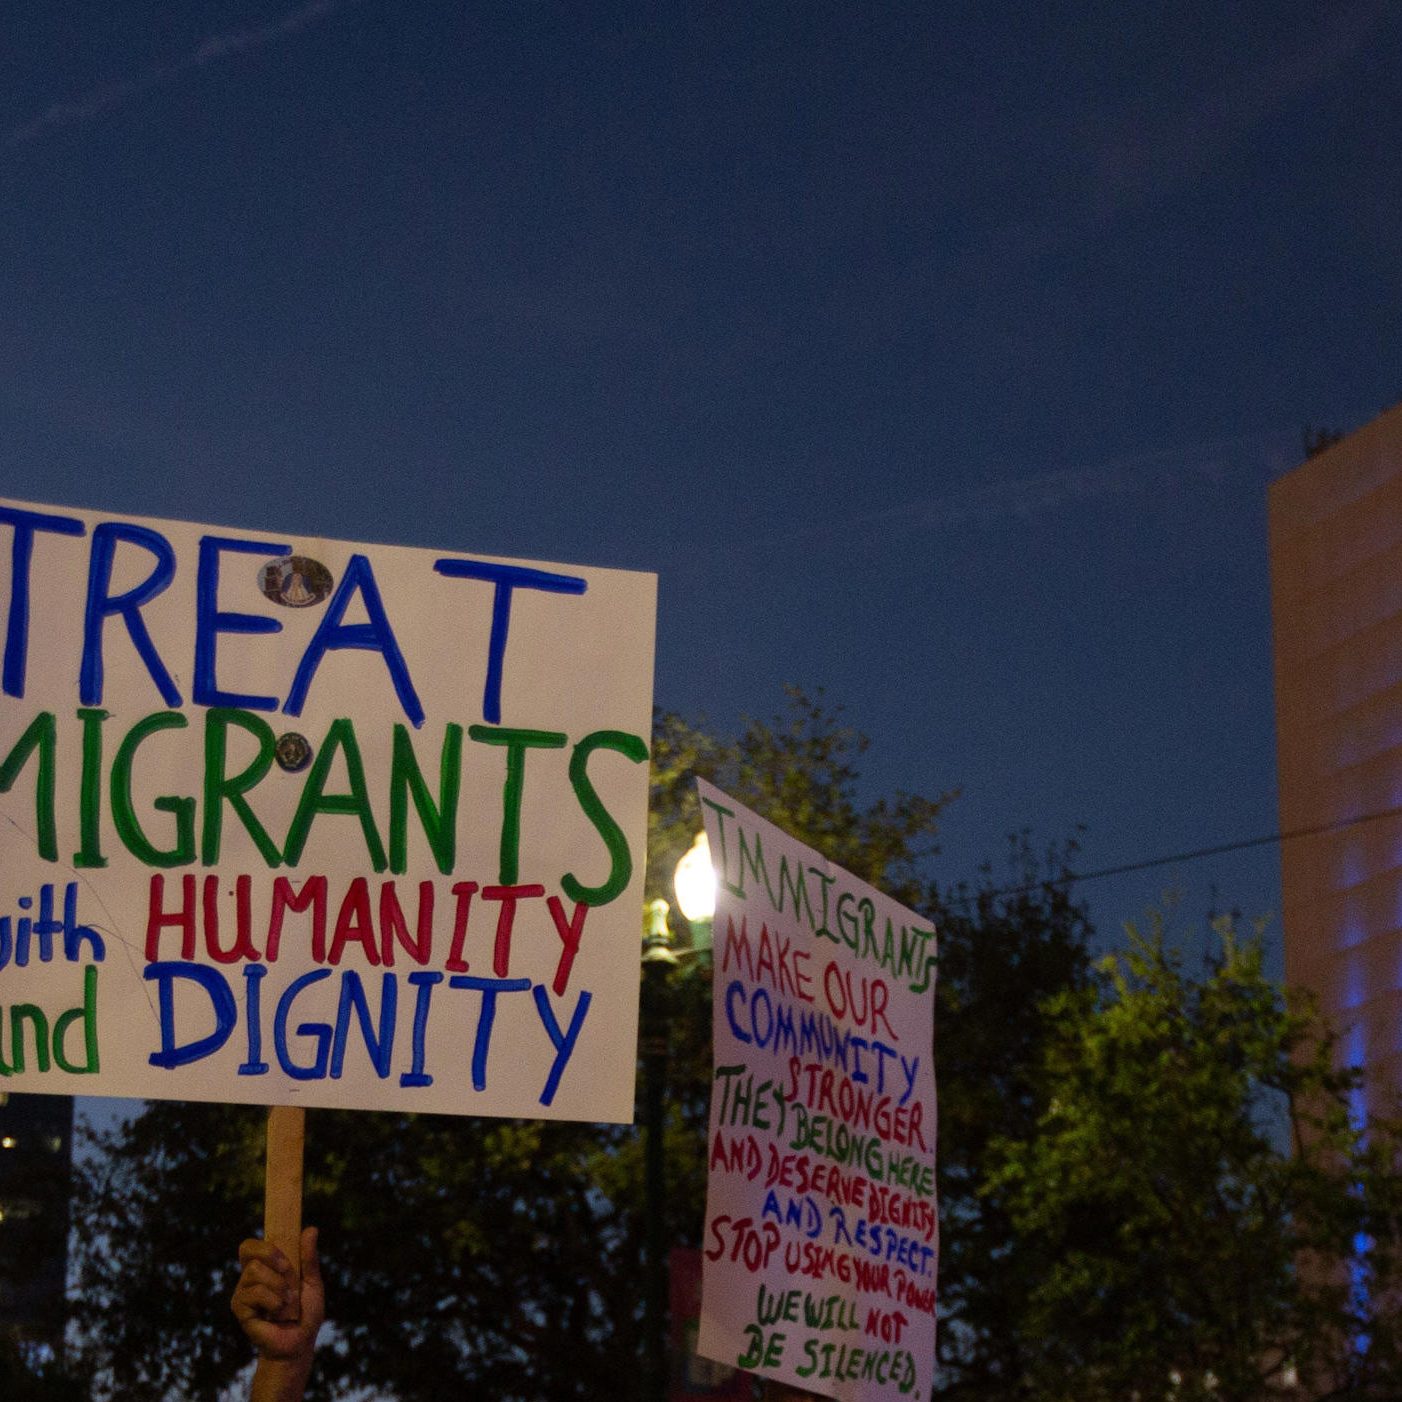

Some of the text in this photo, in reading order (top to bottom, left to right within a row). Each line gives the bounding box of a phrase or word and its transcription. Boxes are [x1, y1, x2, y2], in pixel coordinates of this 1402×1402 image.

[145, 873, 589, 996] HUMANITY
[702, 796, 939, 994] IMMIGRANTS
[144, 961, 592, 1106] DIGNITY
[723, 914, 899, 1041] MAKE OUR
[725, 980, 919, 1104] COMMUNITY
[711, 1131, 936, 1242] AND DESERVE DIGNITY
[716, 1063, 934, 1197] THEY BELONG HERE
[705, 1215, 781, 1273] STOP
[785, 1242, 851, 1283] USING
[853, 1256, 892, 1298] YOUR
[762, 1189, 823, 1239] AND
[738, 1323, 787, 1369] BE
[757, 1284, 909, 1344] WE WILL NOT
